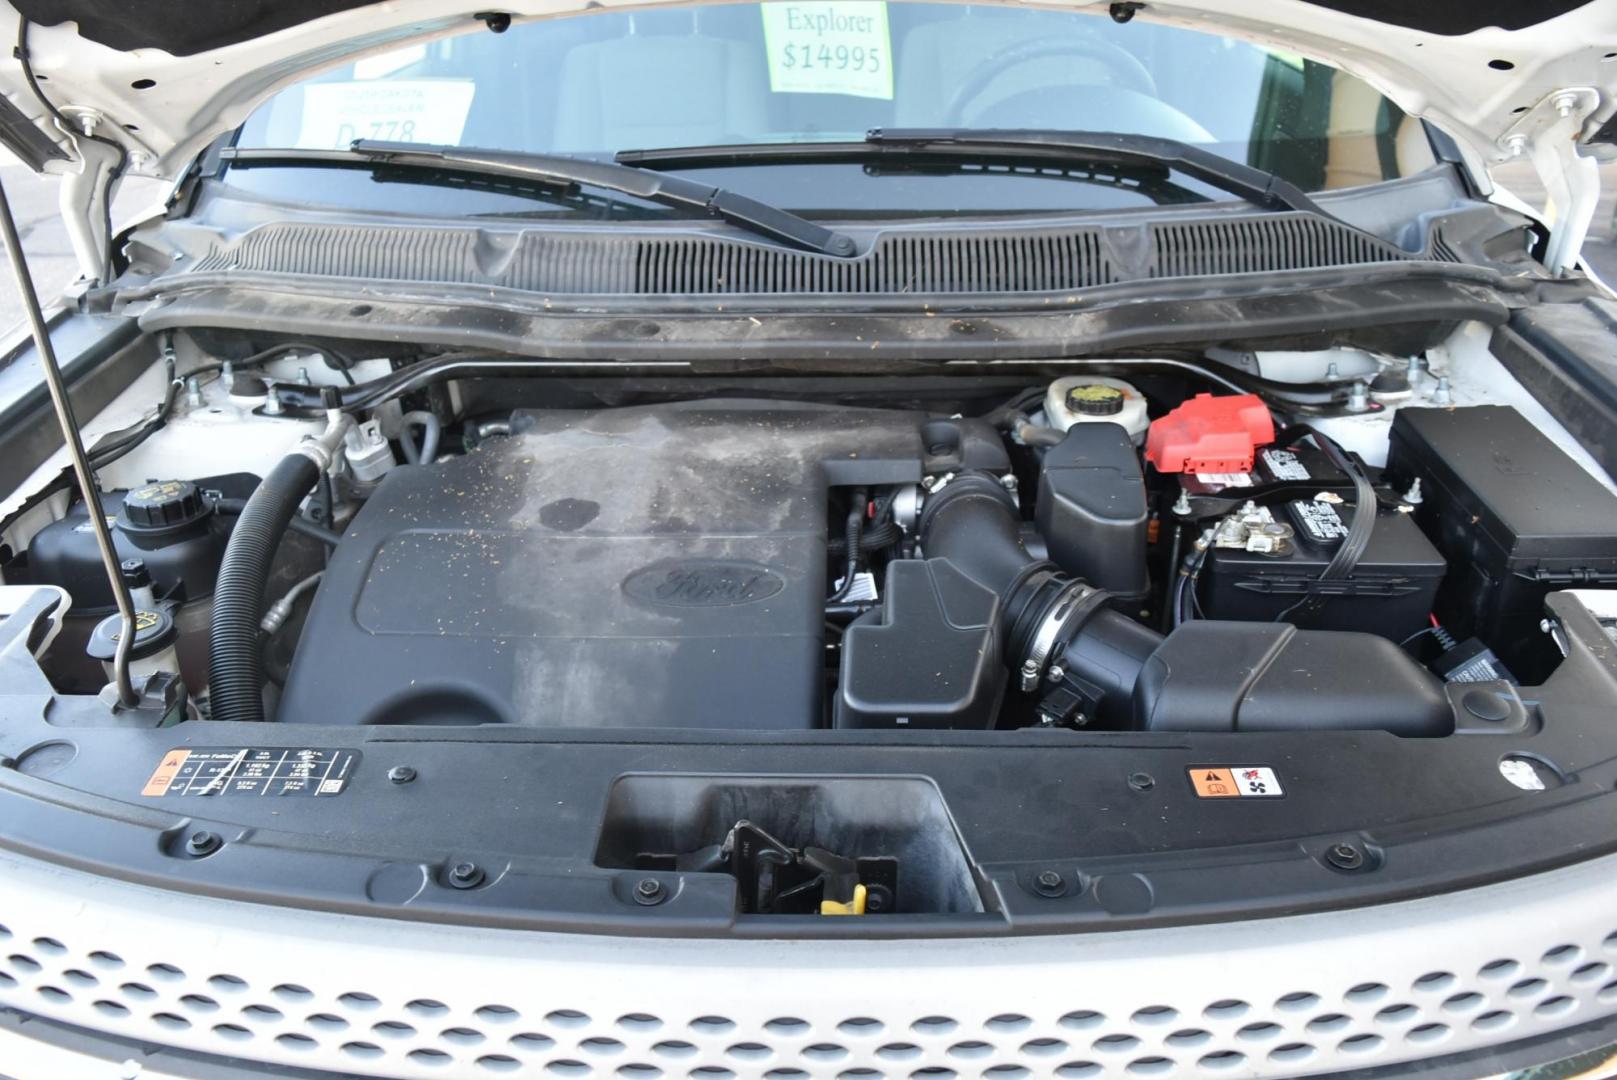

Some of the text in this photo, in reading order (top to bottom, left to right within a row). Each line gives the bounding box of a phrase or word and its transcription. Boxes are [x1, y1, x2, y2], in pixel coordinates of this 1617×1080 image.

[787, 7, 874, 36] Explorer
[782, 42, 880, 73] $14995
[370, 120, 416, 142] 778
[656, 568, 764, 603] Ford
